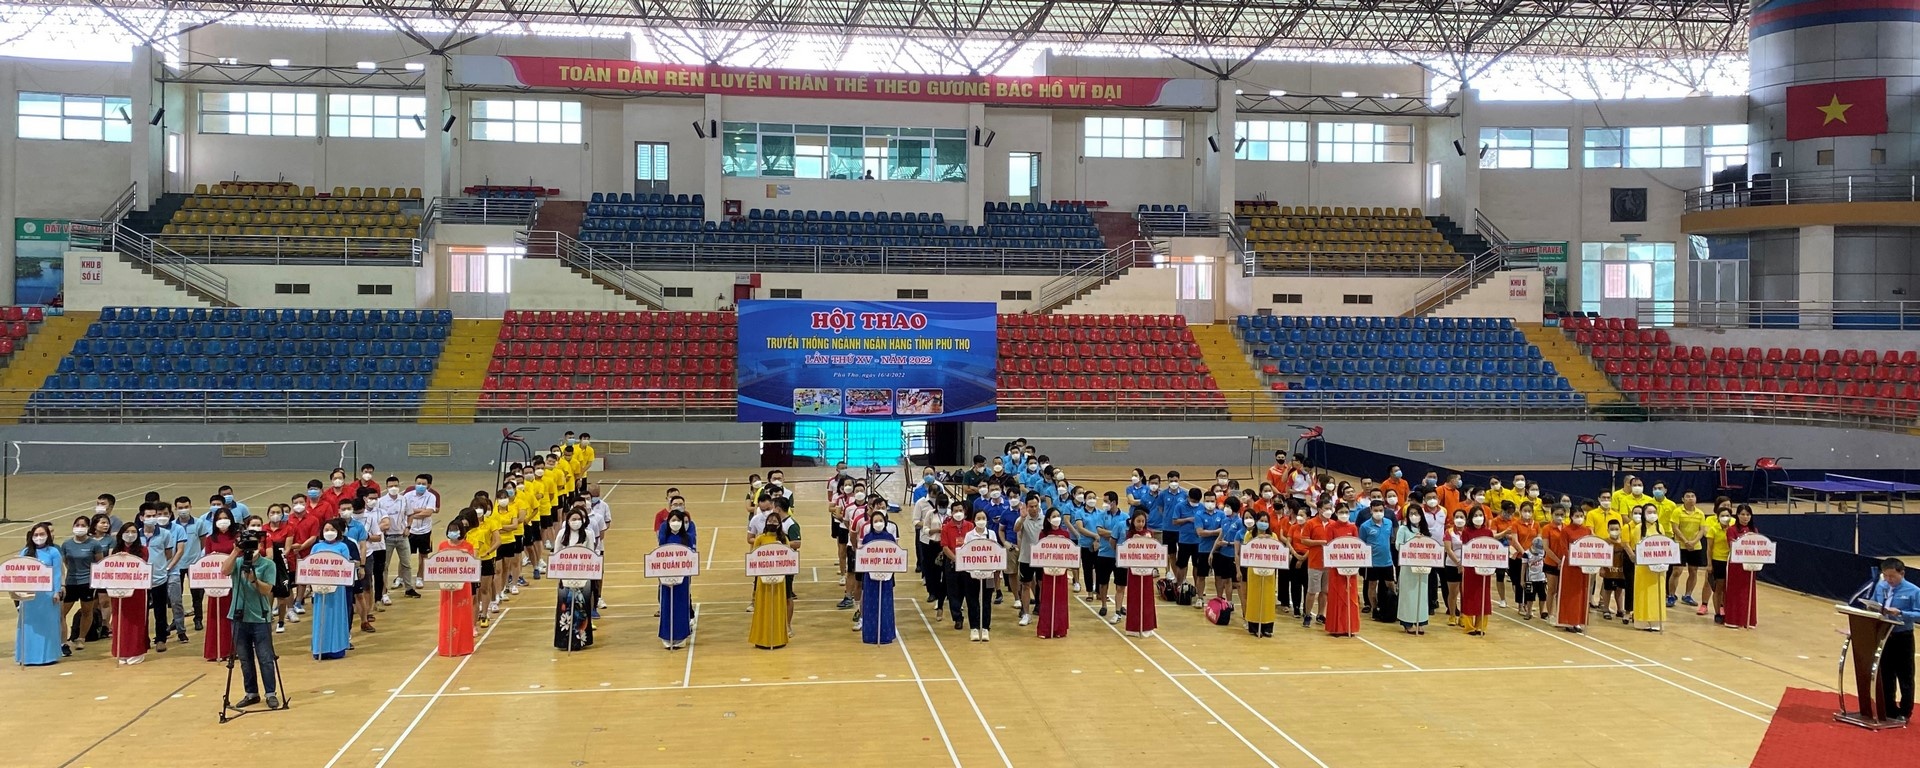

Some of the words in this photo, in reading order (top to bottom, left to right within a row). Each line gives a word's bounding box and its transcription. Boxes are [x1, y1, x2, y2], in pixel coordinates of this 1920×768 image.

[559, 64, 611, 82] TOÀN
[618, 67, 658, 84] DÂN
[665, 69, 704, 87] RÈN
[711, 71, 772, 92] LUYỆN
[778, 75, 828, 91] THÂN
[875, 79, 920, 95] THEO
[927, 79, 990, 97] GƯƠNG
[996, 80, 1032, 98] BÁC
[1039, 79, 1063, 99] HỒ
[1069, 84, 1086, 99] VĨ
[1091, 84, 1122, 102] ĐẠI
[811, 307, 856, 334] HỘI
[860, 312, 928, 330] THAO
[856, 355, 873, 364] XV
[908, 356, 932, 364] 2022
[1120, 552, 1128, 560] NH
[1653, 550, 1667, 558] NAM
[749, 560, 758, 569] NH
[860, 557, 869, 565] NH
[882, 557, 894, 565] TÁC
[962, 555, 988, 566] TRỌNG
[989, 554, 1002, 563] TÀI
[438, 565, 458, 574] CHÍNH
[458, 565, 476, 574] SÁCH
[651, 562, 661, 570] NH
